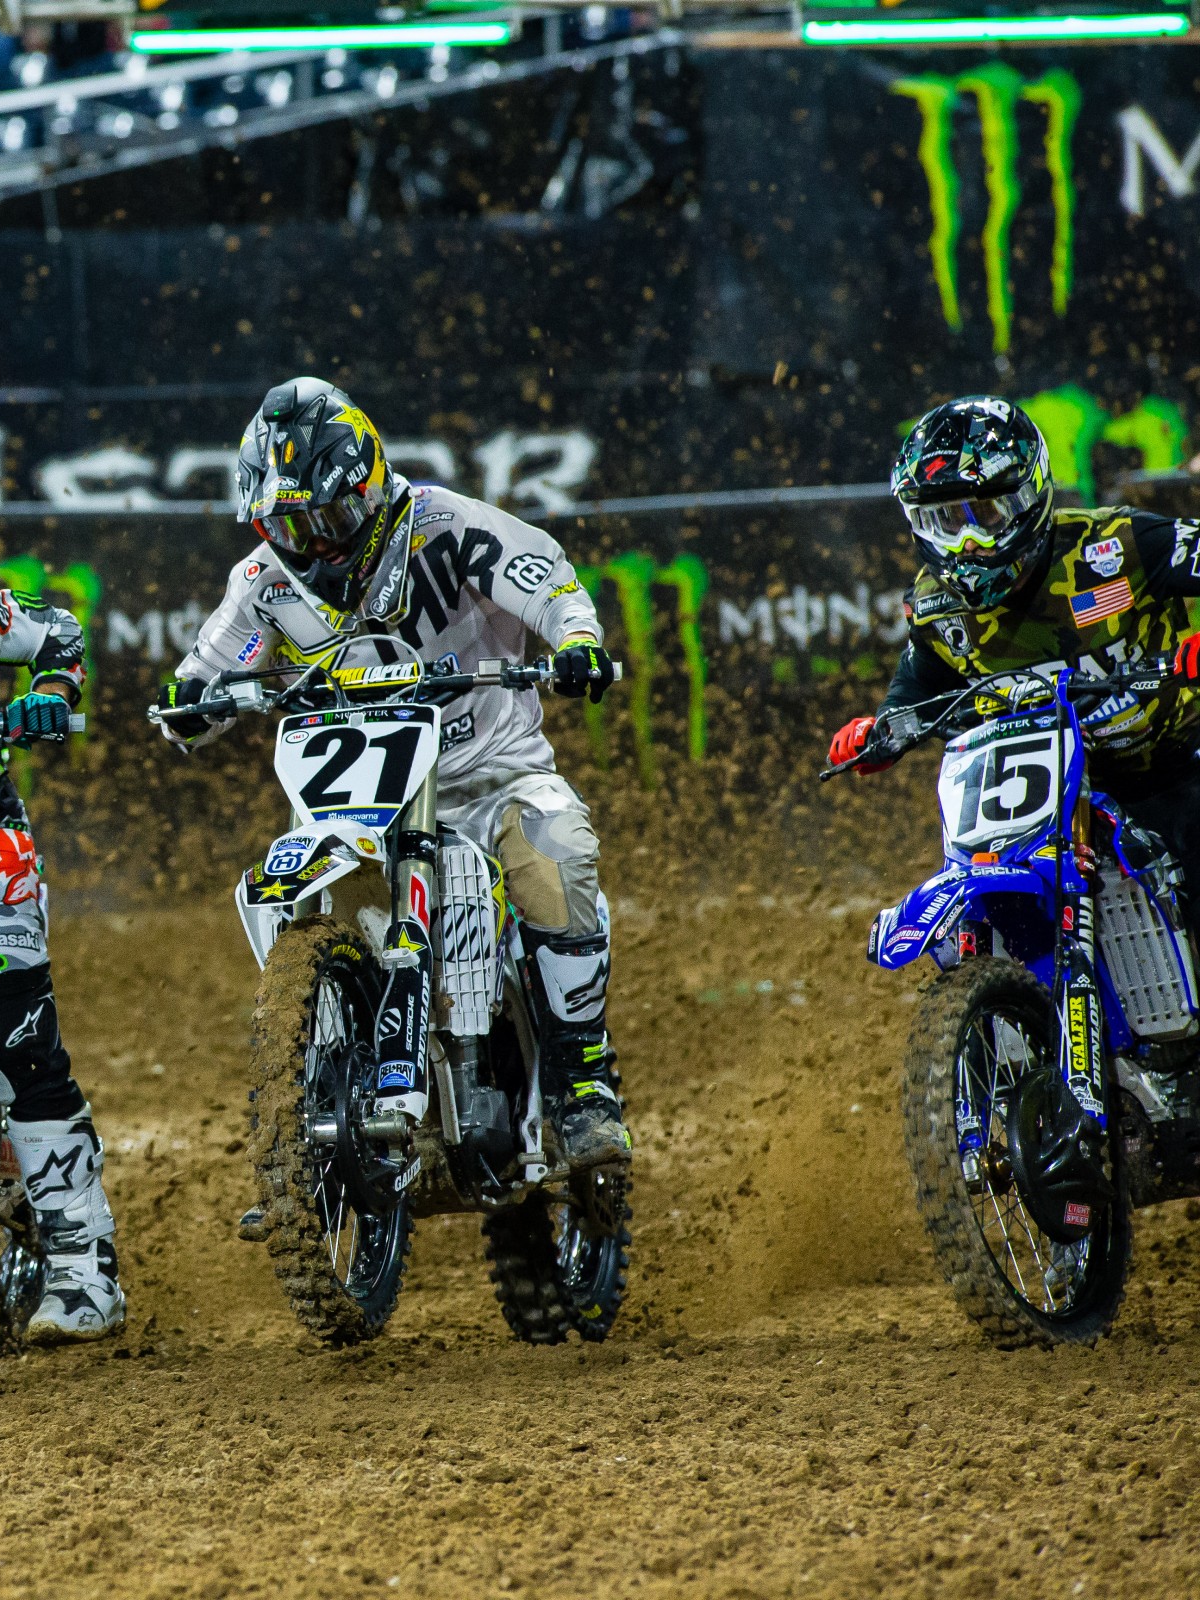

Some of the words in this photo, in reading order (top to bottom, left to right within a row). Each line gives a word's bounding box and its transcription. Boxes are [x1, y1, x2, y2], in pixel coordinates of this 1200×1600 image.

[322, 465, 343, 491] Airoh
[413, 513, 454, 529] OSCHE
[1090, 540, 1120, 558] AMA
[1130, 681, 1160, 690] ARC
[299, 726, 422, 809] 21
[954, 737, 1052, 837] 15
[917, 893, 951, 924] YAMAHA
[417, 970, 430, 1075] DUNLOP
[1069, 996, 1087, 1072] GALFER
[1089, 993, 1102, 1090] DUNLOP
[1066, 1213, 1089, 1225] SPEED
[1068, 1203, 1090, 1214] LIGHT
